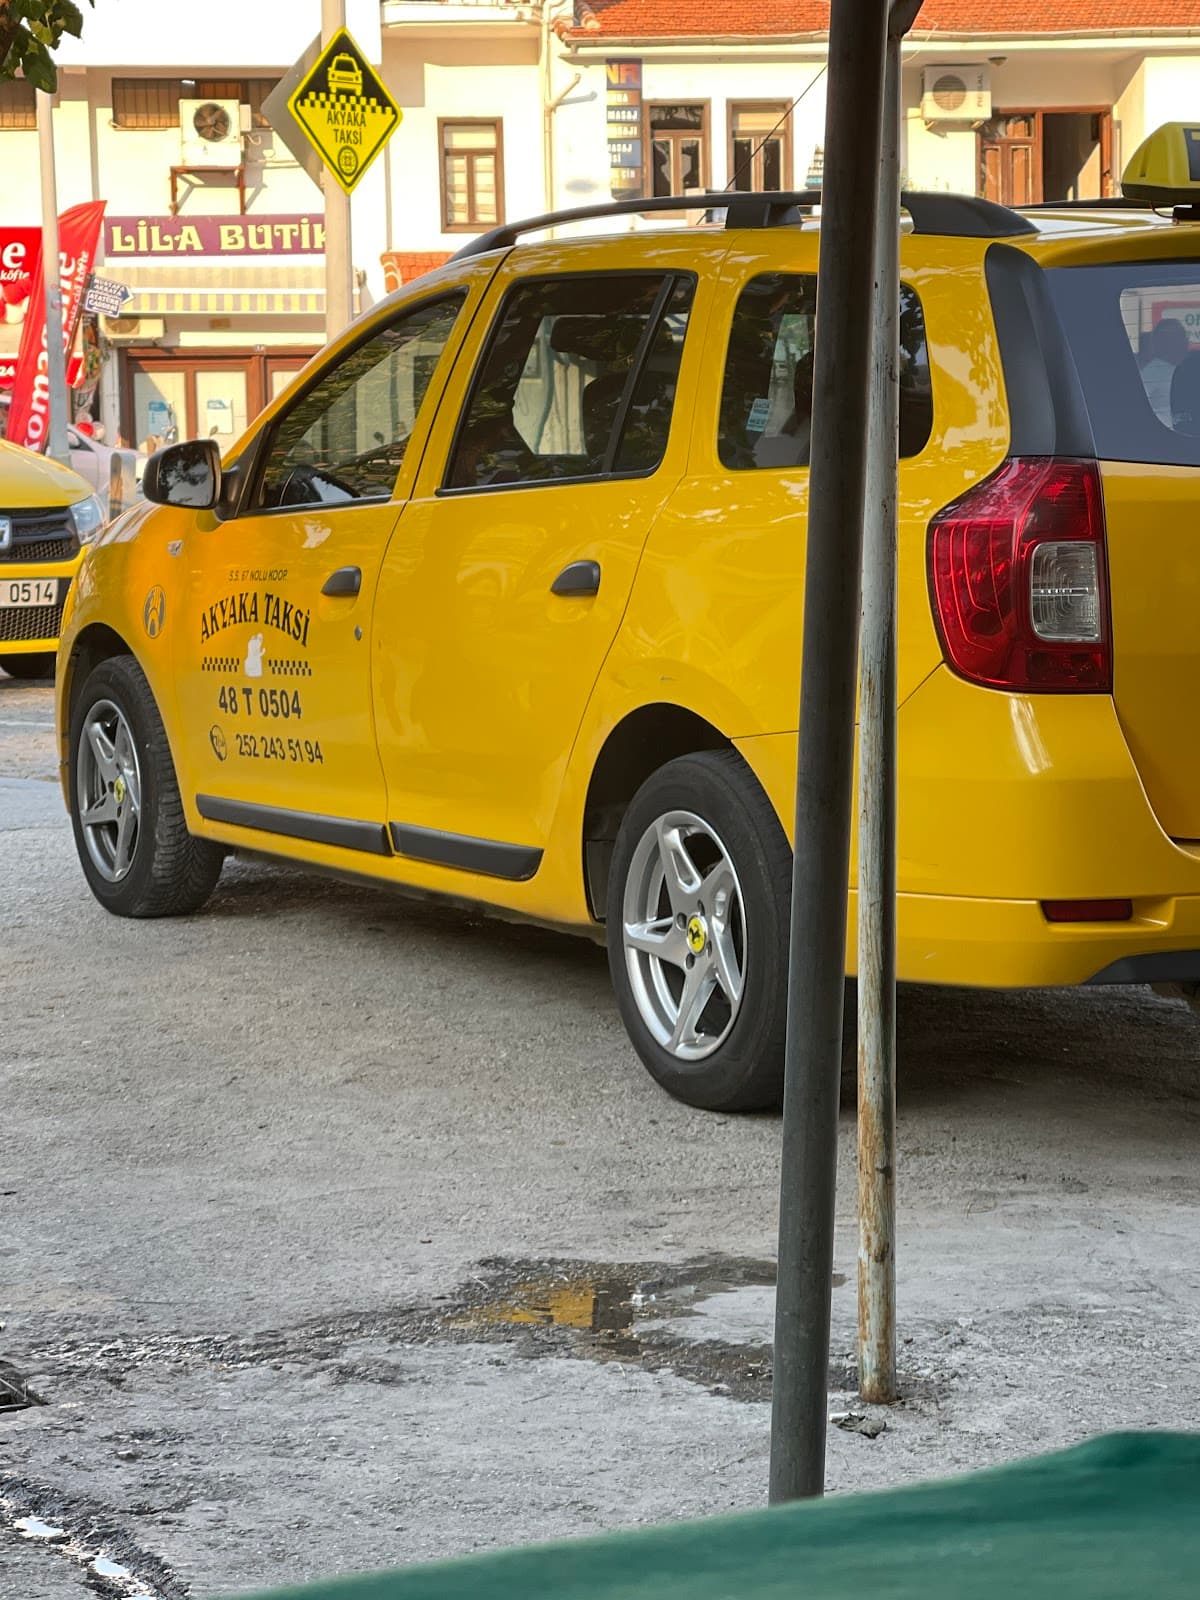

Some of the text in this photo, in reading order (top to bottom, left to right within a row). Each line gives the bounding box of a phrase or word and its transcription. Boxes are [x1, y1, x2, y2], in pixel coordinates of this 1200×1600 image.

[326, 110, 367, 127] AKYAKA
[333, 127, 363, 145] TAKSİ
[111, 217, 326, 252] LİLA BUTİK
[250, 570, 269, 582] NOLU
[9, 582, 54, 603] 0514
[200, 591, 311, 648] AKYAKA TAKSİ
[218, 685, 302, 720] 48 T 0504
[235, 733, 260, 758] 252
[260, 735, 287, 761] 243
